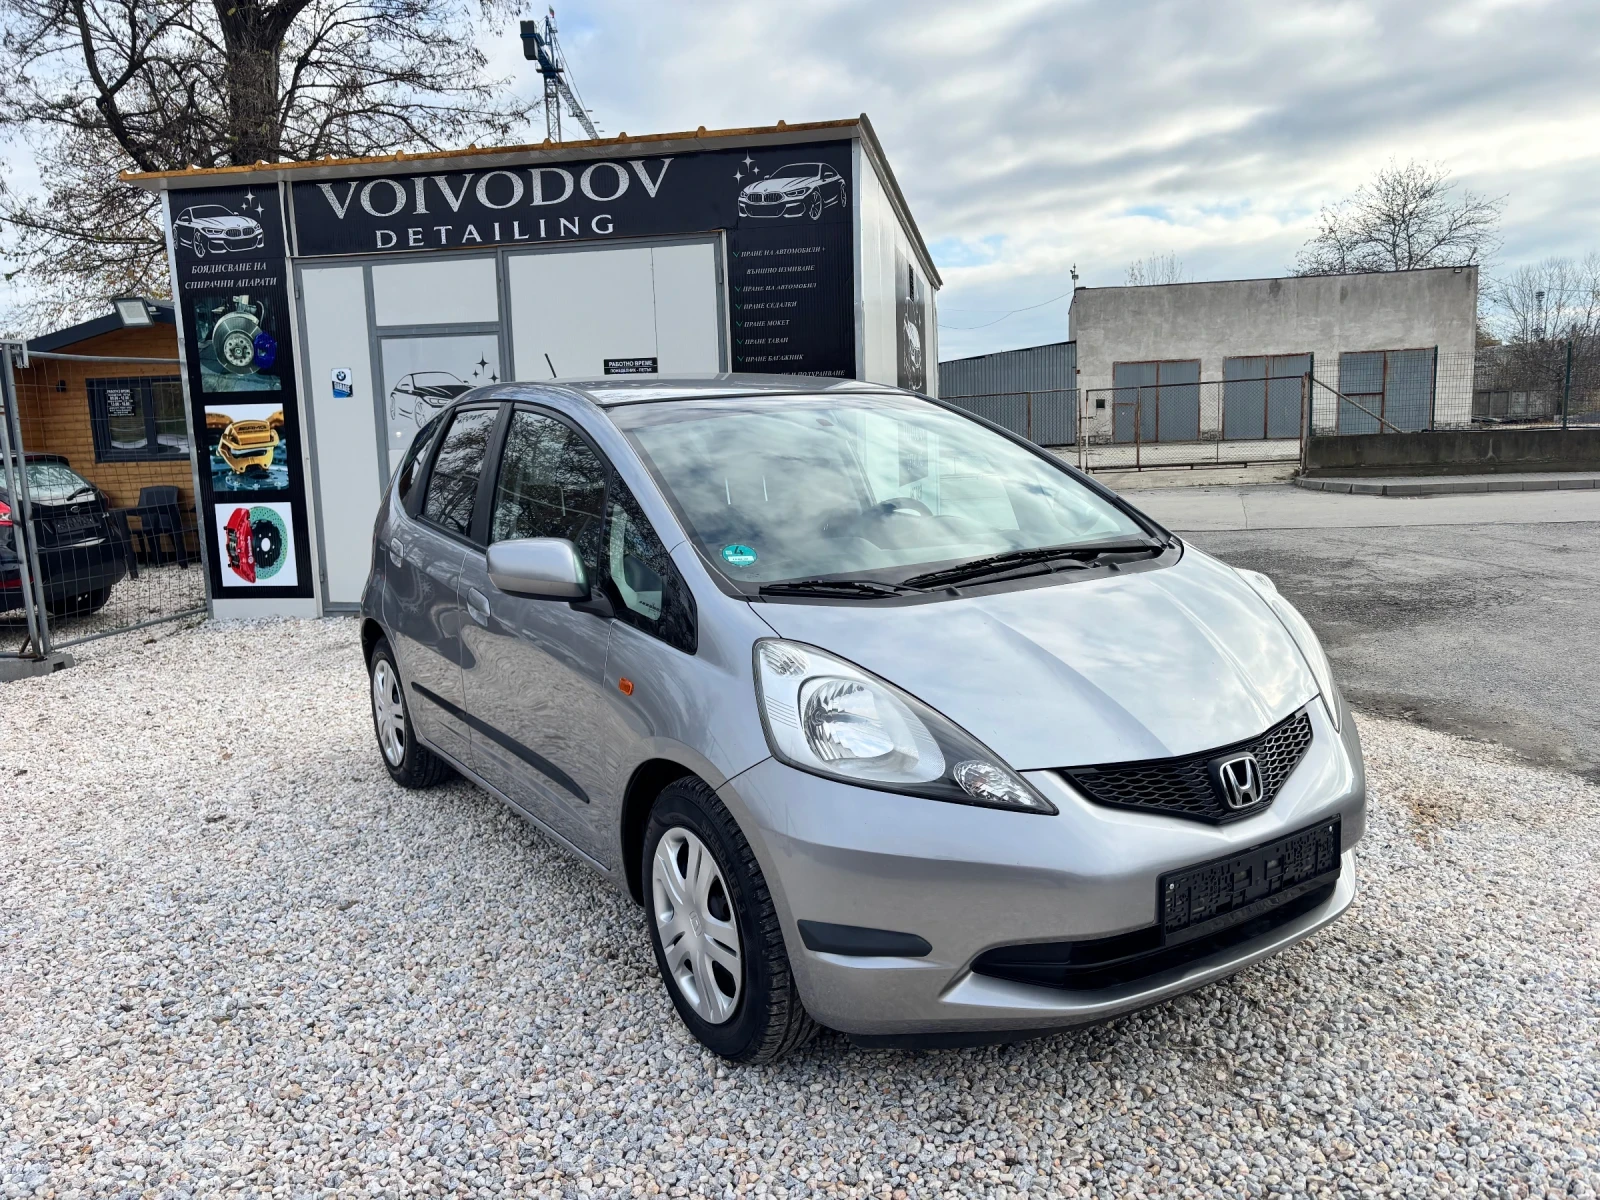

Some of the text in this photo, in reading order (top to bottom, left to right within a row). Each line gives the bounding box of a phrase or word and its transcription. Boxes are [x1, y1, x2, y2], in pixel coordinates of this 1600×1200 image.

[316, 157, 674, 219] VOIVODOV
[375, 214, 614, 249] DETAILING
[775, 246, 821, 255] АВТОМОБИЛИ
[191, 262, 266, 274] БОЯДИСВАНЕ НА
[778, 265, 815, 273] ИЗМИВАНЕ
[184, 277, 277, 289] СПИРАЧНИ АПАРАТИ
[776, 282, 817, 290] АВТОМОБИЛ
[766, 301, 797, 309] СЕДАЛКИ
